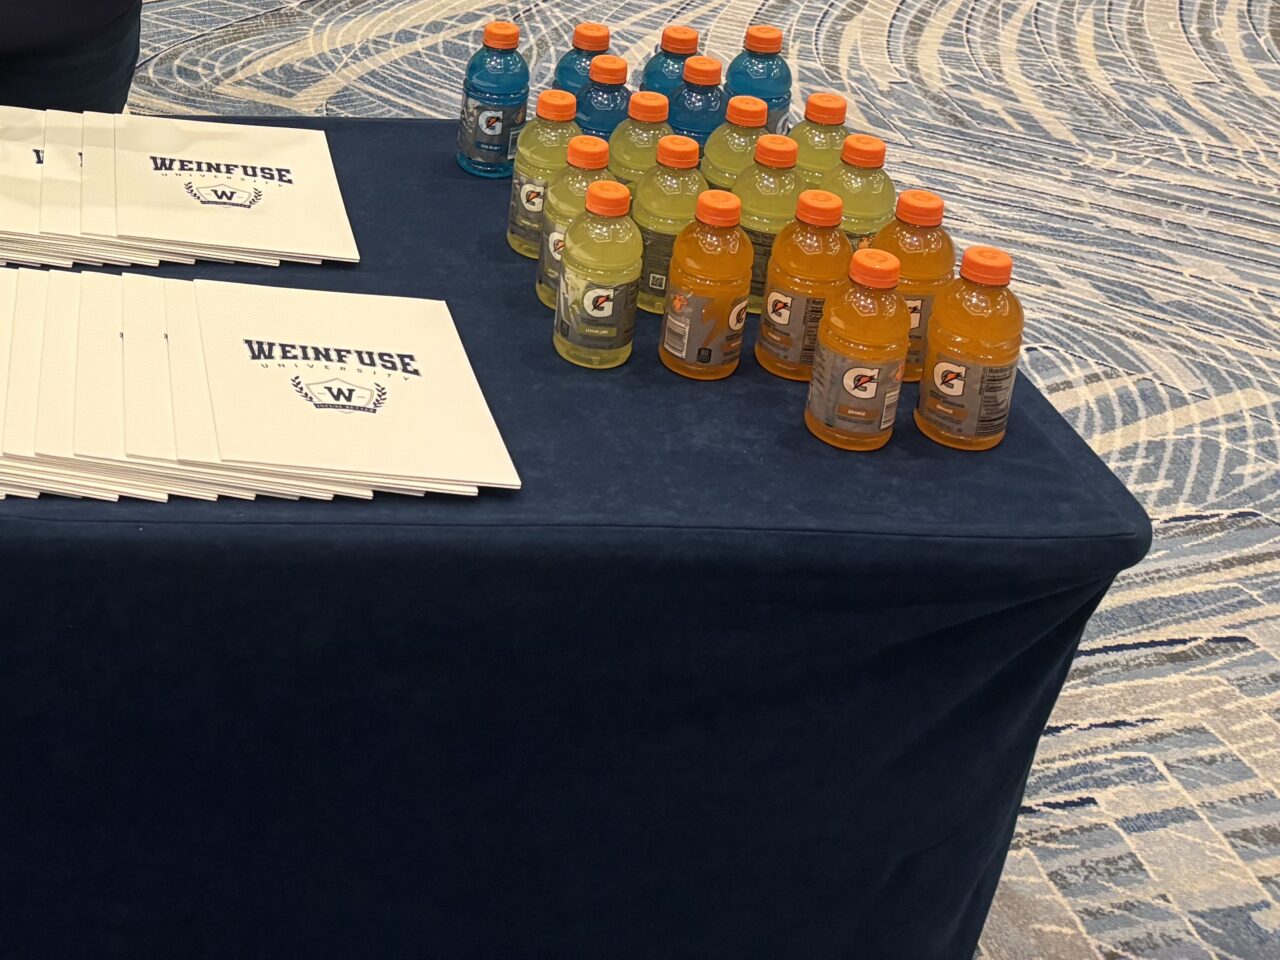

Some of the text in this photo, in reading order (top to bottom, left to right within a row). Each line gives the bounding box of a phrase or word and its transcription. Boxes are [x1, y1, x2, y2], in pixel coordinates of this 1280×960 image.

[478, 110, 503, 136] G
[149, 155, 293, 185] WEINFUSE
[211, 189, 237, 201] W
[521, 183, 544, 212] G
[583, 288, 614, 318] G
[767, 291, 792, 325] G
[243, 339, 422, 377] WEINFUSE
[261, 363, 409, 381] UNIVERSITY
[843, 367, 879, 399] G
[933, 361, 966, 396] G
[324, 386, 356, 402] W
